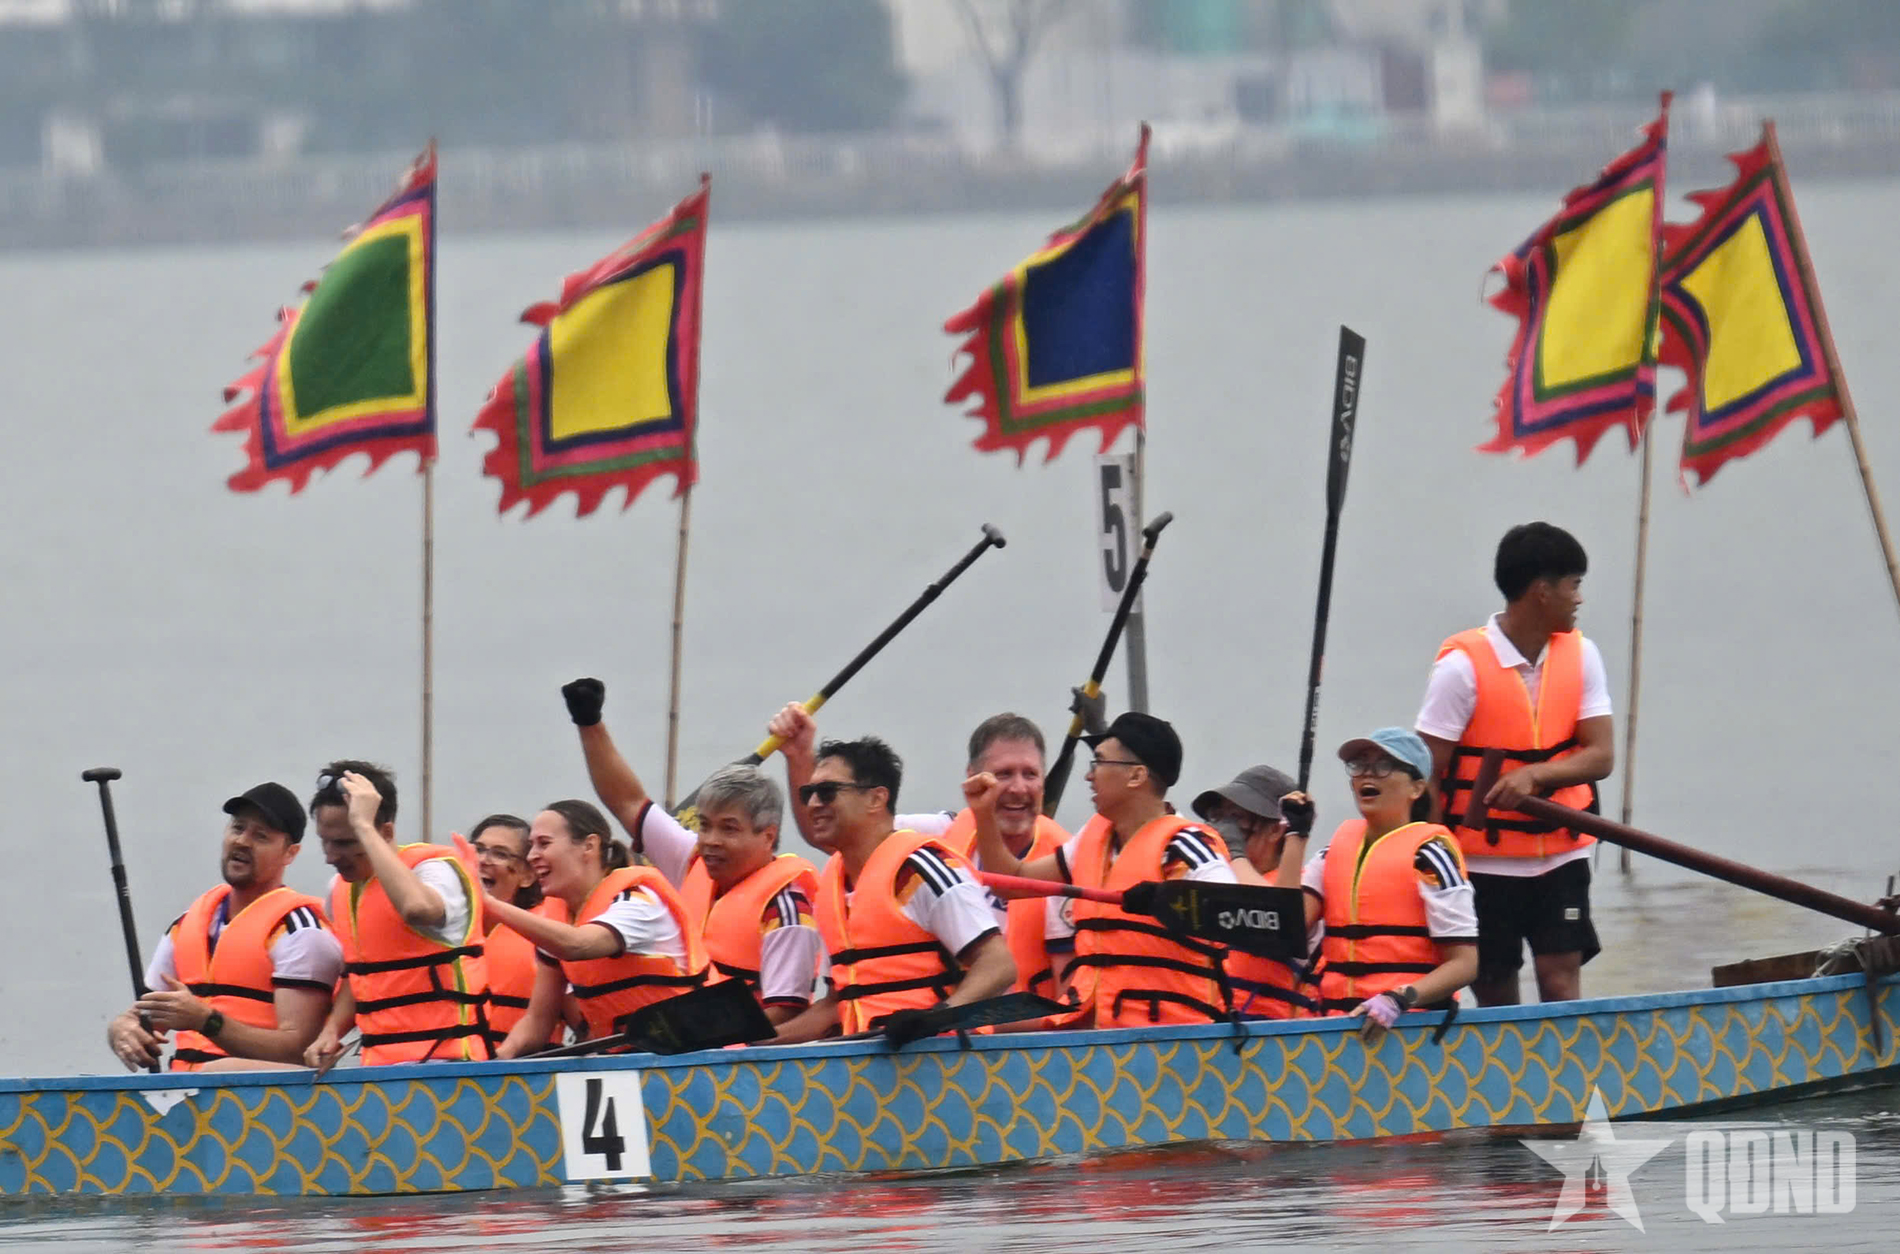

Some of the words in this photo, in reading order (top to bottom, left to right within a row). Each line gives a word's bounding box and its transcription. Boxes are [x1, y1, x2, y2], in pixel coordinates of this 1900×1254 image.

[1340, 355, 1357, 434] BIDV
[1101, 464, 1127, 593] 5
[1236, 908, 1280, 930] BIDV
[582, 1078, 625, 1171] 4
